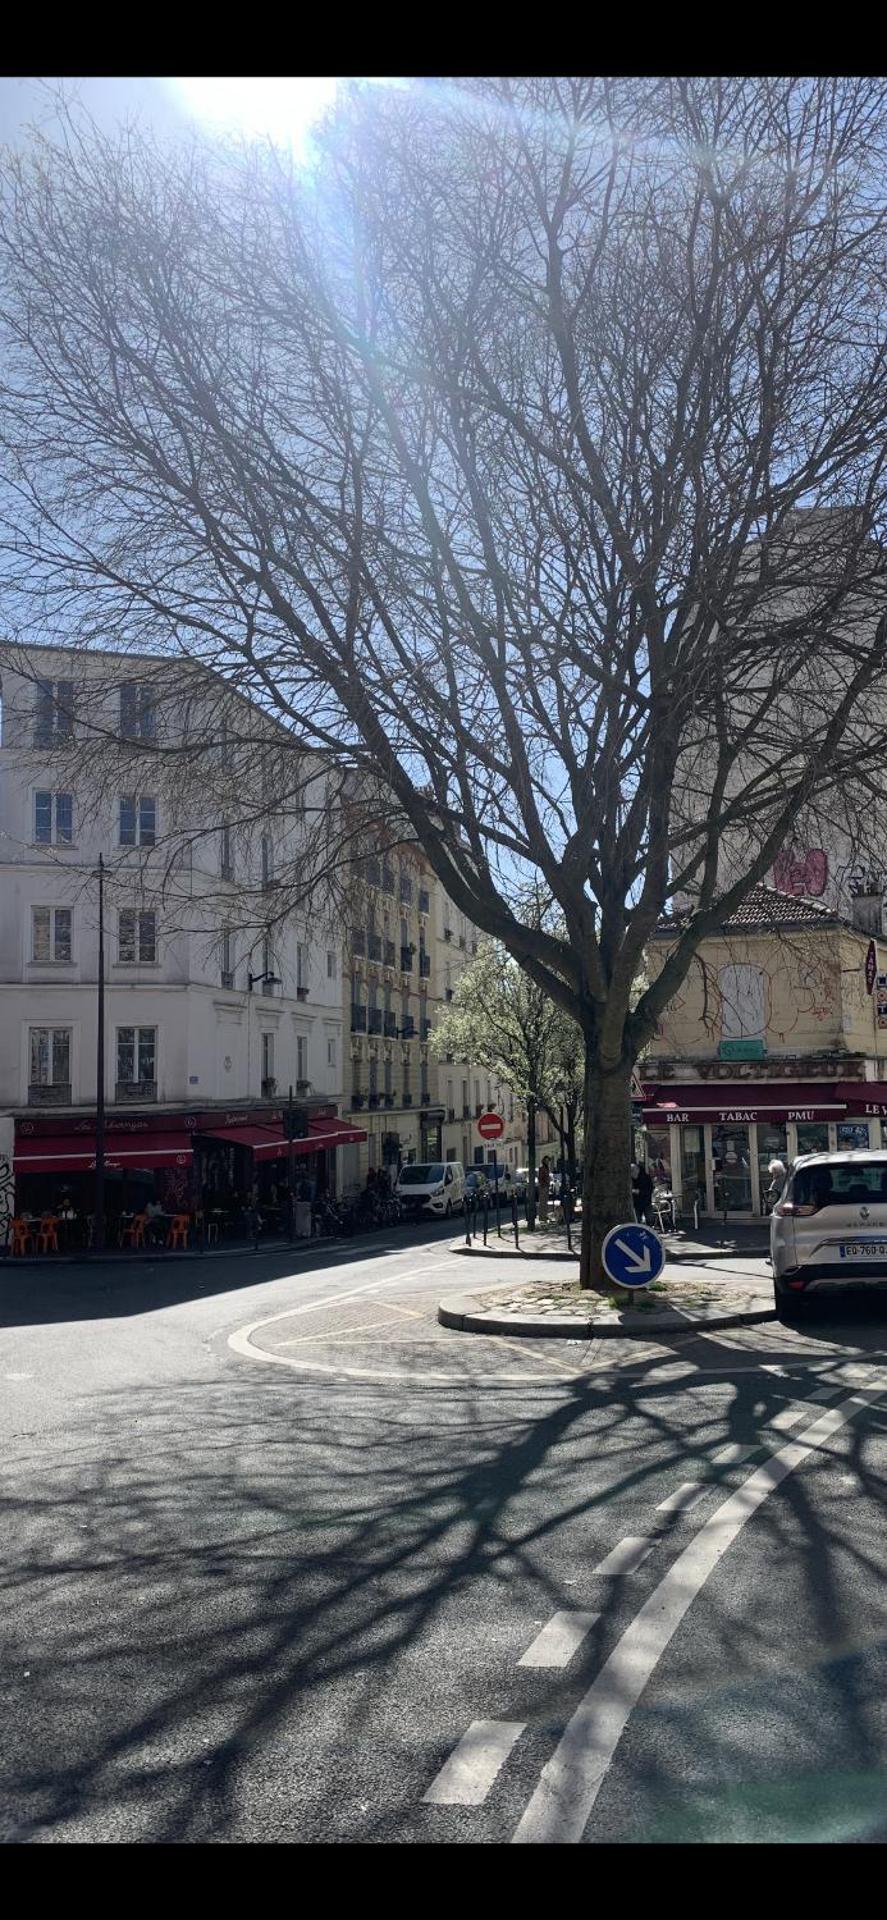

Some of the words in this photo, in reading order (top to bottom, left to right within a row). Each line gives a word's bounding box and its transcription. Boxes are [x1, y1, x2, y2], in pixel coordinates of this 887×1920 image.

[865, 1104, 881, 1115] LE
[666, 1113, 689, 1122] BAR
[719, 1111, 758, 1121] TABAC
[787, 1111, 815, 1121] PMU
